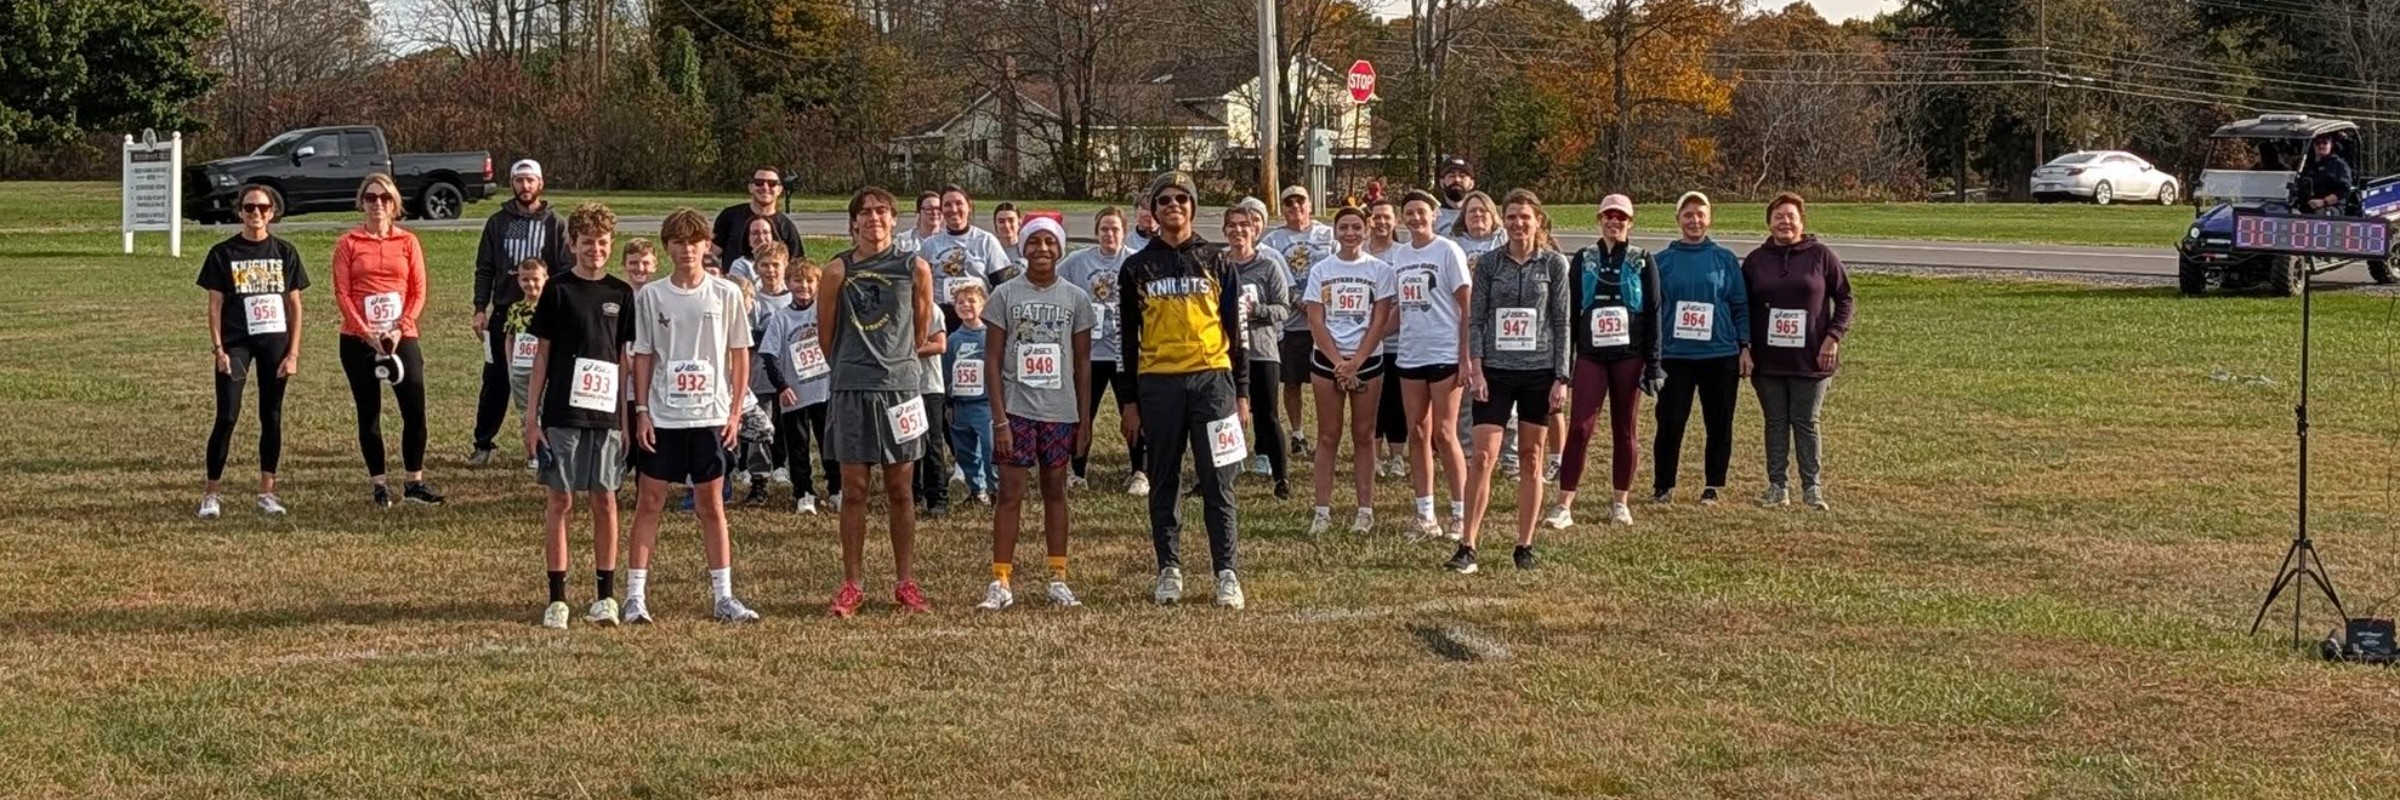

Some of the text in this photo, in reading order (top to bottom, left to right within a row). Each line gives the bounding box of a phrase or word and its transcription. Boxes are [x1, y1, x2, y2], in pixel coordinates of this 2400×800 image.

[1350, 73, 1373, 90] STOP
[1145, 277, 1210, 298] KNIGHTS
[1339, 294, 1363, 310] 967
[253, 305, 278, 321] 958
[373, 303, 396, 320] 957
[1011, 303, 1073, 326] BATTLE
[1682, 311, 1706, 328] 964
[1502, 319, 1529, 336] 947
[1598, 317, 1621, 334] 953
[1775, 319, 1799, 335] 965
[799, 346, 822, 367] 935
[1025, 356, 1053, 374] 948
[582, 373, 611, 395] 933
[677, 372, 706, 391] 932
[899, 411, 924, 435] 951
